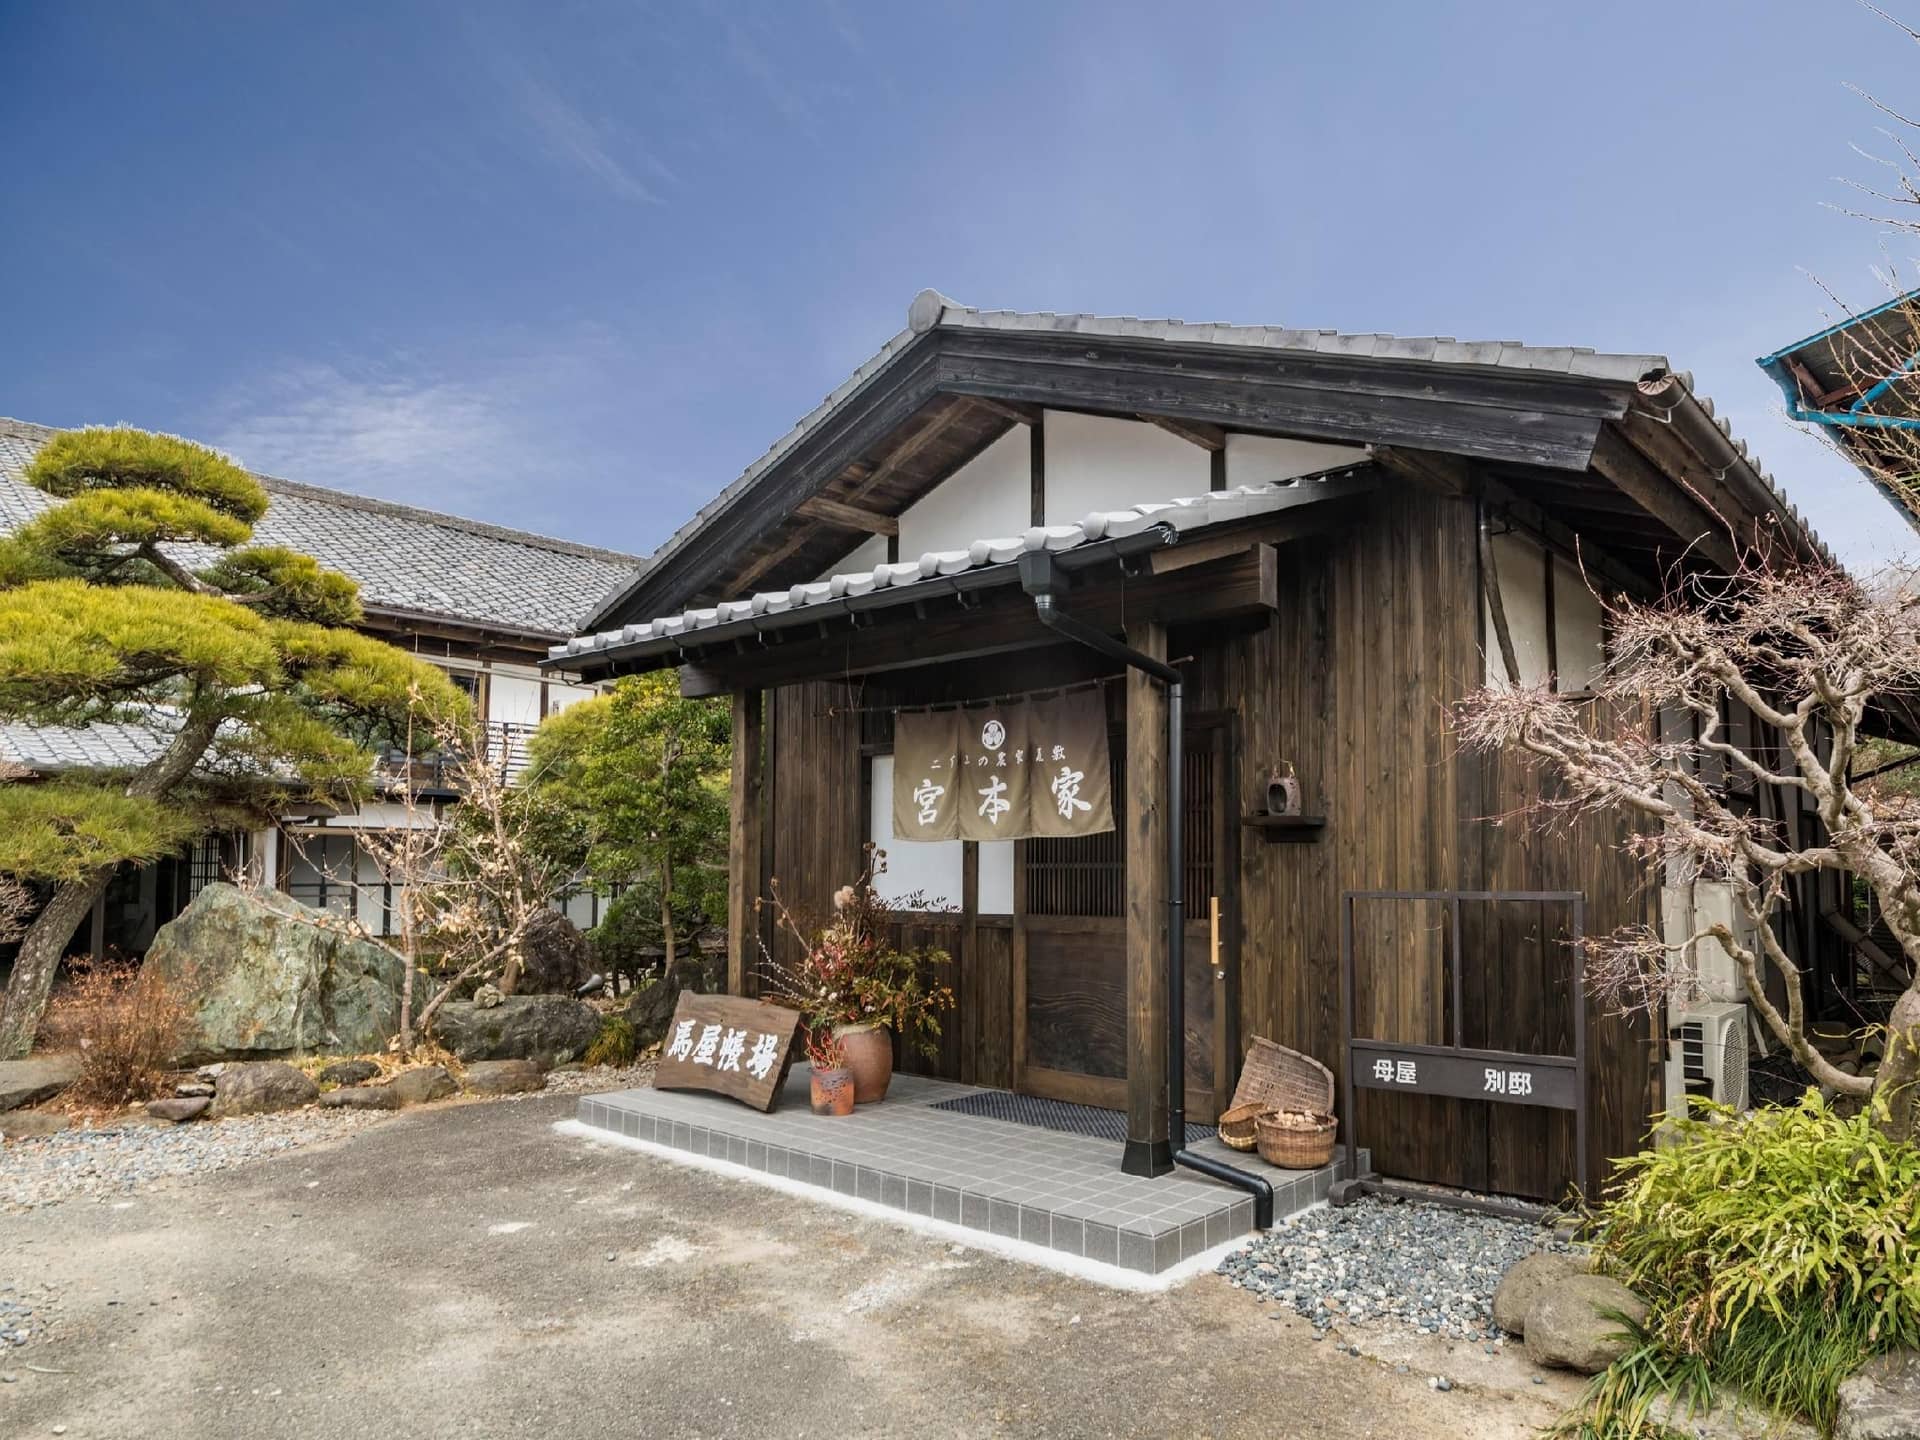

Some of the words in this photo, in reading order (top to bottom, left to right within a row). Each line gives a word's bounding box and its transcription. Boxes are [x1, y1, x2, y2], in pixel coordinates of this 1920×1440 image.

[913, 766, 1092, 826] 宮本家
[1372, 1059, 1418, 1085] 母屋
[1483, 1068, 1533, 1096] 別邸
